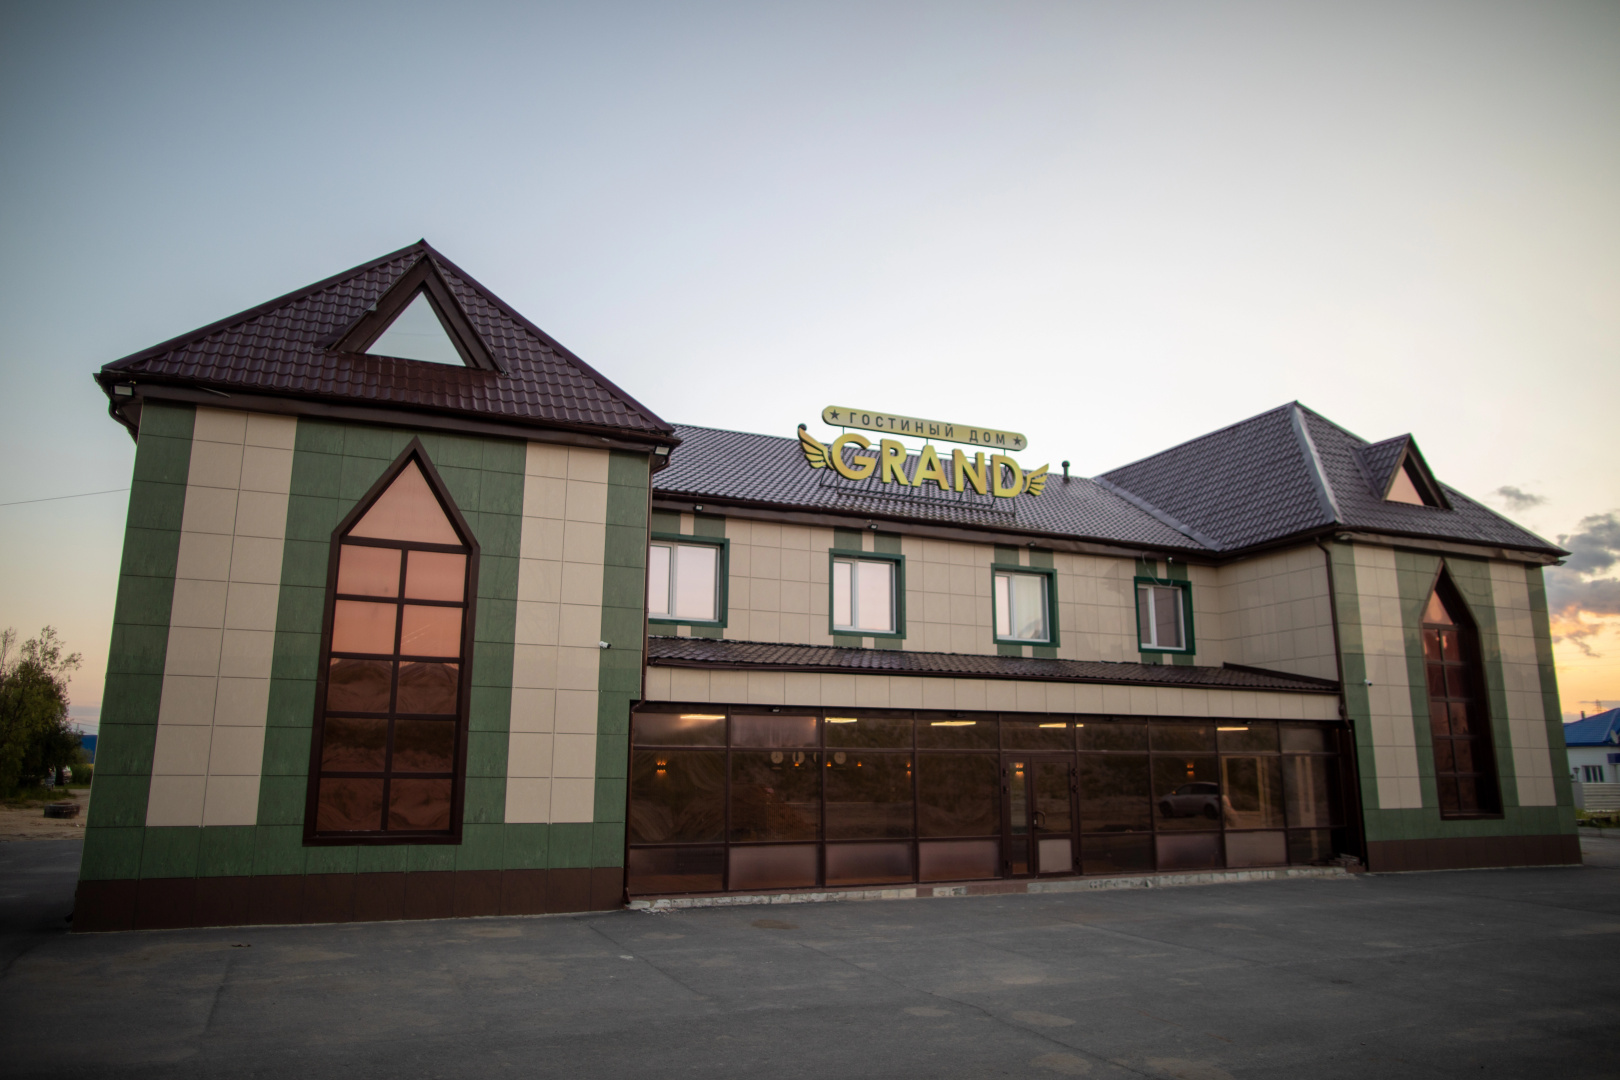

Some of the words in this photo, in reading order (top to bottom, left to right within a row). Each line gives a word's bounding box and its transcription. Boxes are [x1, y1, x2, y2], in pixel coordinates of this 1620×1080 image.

[850, 411, 954, 438] ГОСТИНЫЙ
[969, 429, 1006, 446] ДОМ
[831, 432, 1024, 498] GRAND
